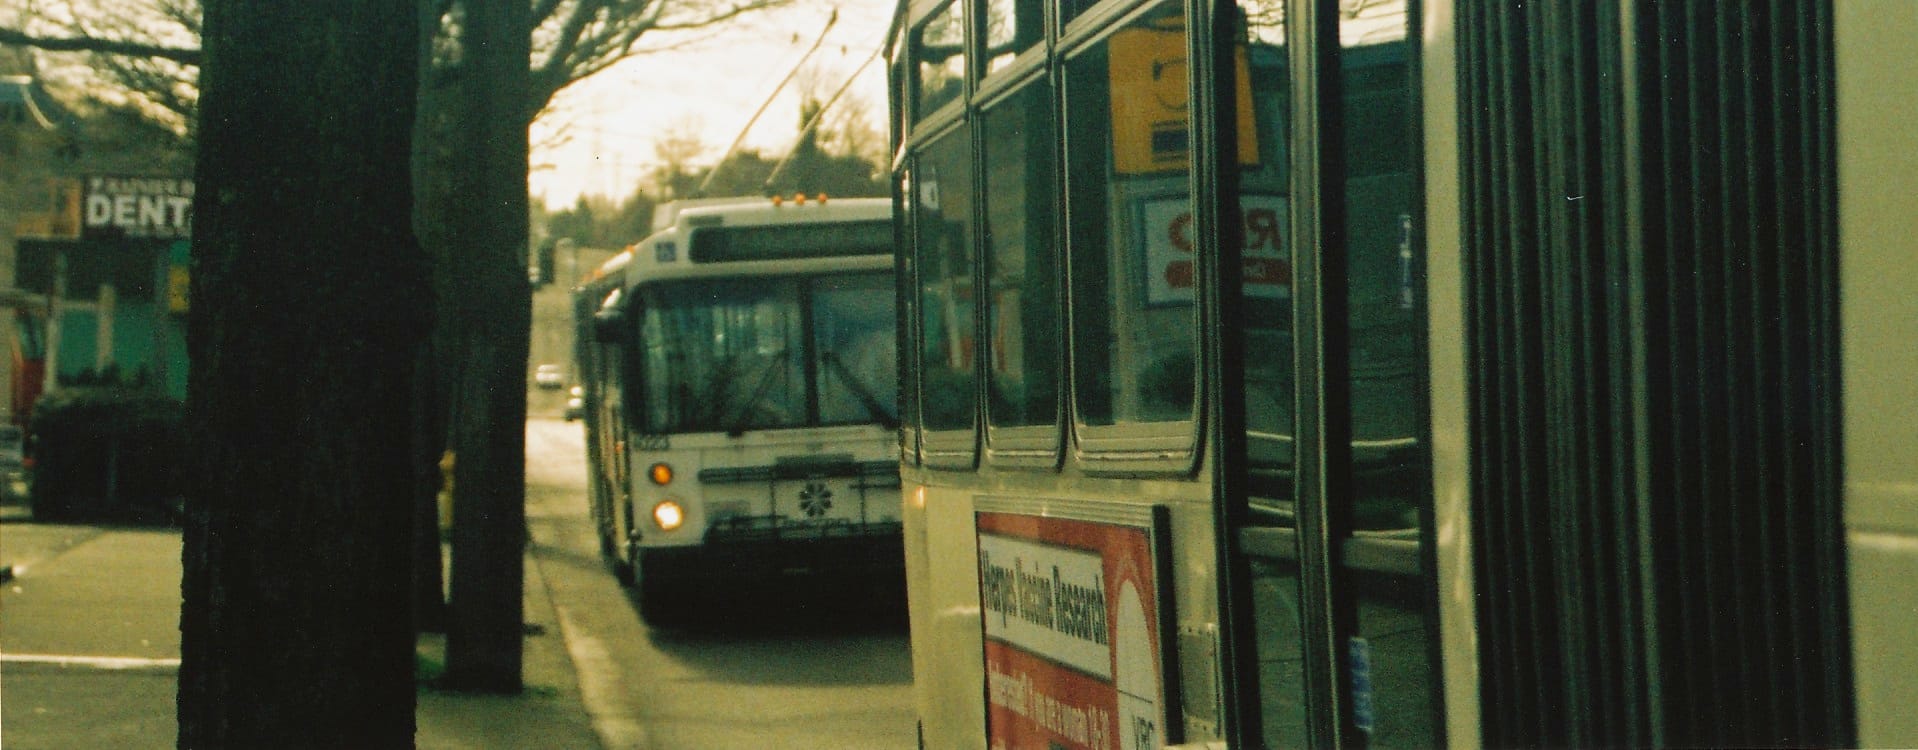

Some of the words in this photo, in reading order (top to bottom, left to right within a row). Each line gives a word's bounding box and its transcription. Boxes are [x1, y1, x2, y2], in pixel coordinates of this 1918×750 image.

[981, 549, 1017, 629] Herpes
[1015, 557, 1052, 630] Vaccine
[1052, 565, 1107, 646] Research
